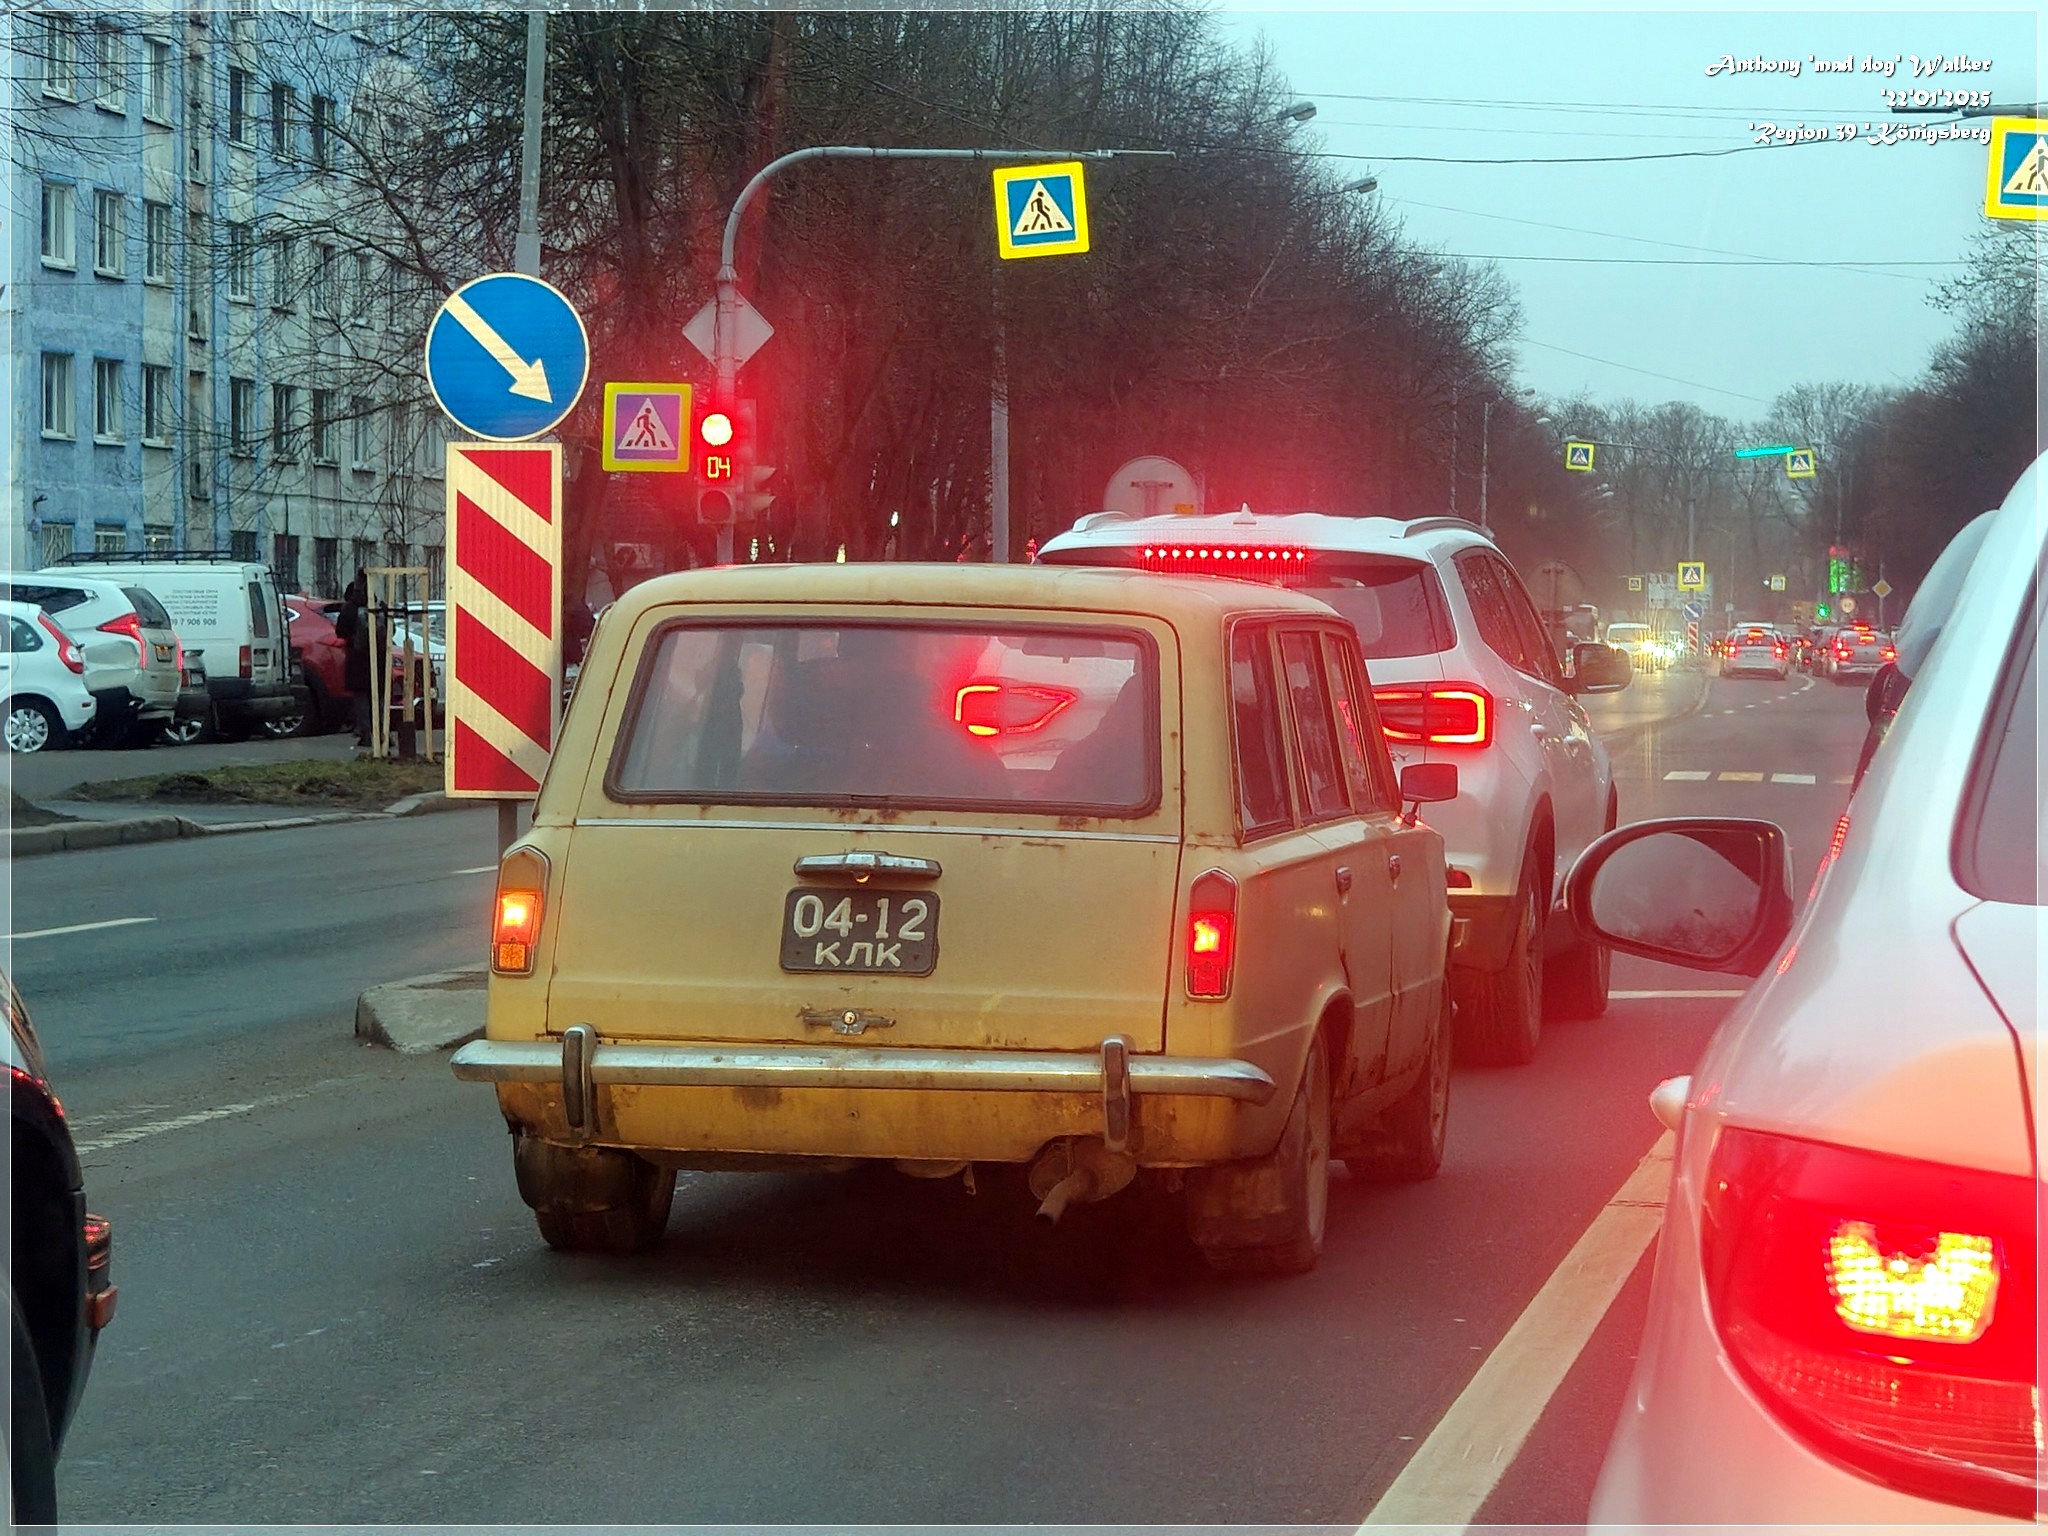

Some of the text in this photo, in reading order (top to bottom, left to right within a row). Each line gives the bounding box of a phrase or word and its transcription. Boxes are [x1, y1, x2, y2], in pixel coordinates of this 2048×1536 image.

[707, 456, 731, 479] 04
[793, 894, 929, 941] 04-12
[815, 942, 902, 967] КЛК
